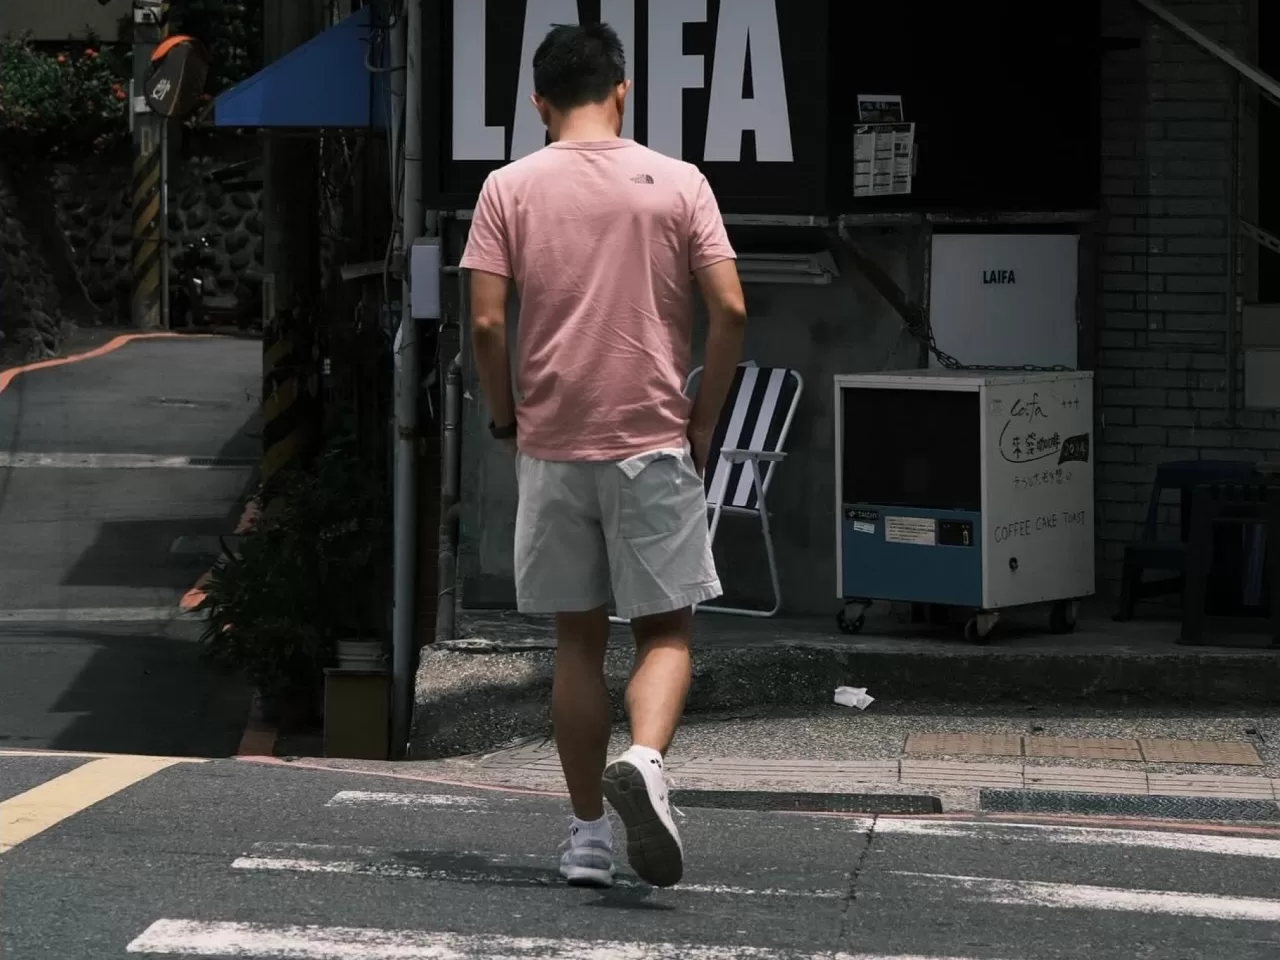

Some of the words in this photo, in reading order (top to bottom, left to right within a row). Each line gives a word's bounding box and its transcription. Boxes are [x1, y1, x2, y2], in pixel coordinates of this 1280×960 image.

[982, 269, 1016, 285] LAIFA
[993, 519, 1031, 543] COFFEE
[1035, 513, 1057, 531] CAKE
[1062, 510, 1086, 526] TOAST
